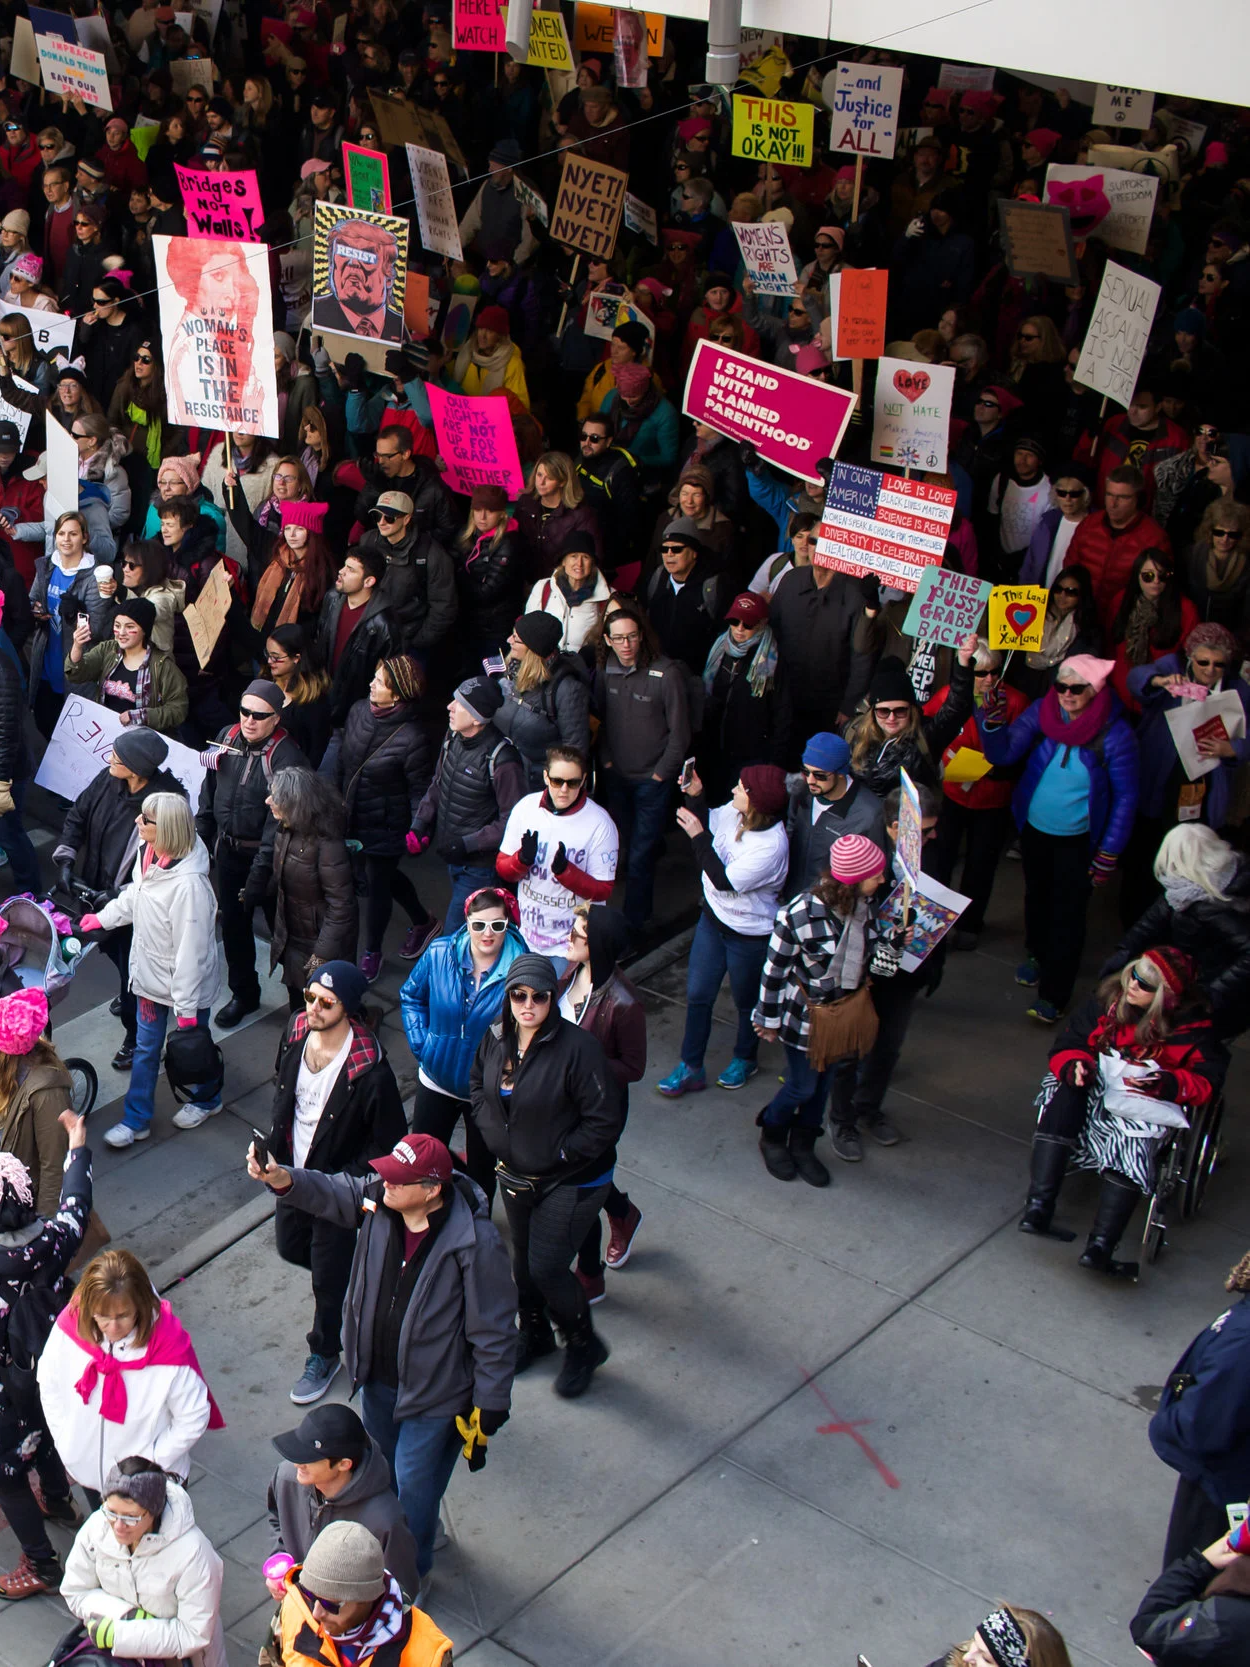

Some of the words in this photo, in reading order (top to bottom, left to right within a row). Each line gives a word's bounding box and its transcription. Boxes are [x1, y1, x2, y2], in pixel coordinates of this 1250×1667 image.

[456, 26, 498, 46] WATCH
[40, 49, 76, 67] DONALD
[77, 60, 107, 76] TRUMP
[51, 40, 96, 61] IMPEACH
[50, 71, 75, 86] SAVE
[77, 79, 97, 94] OUR
[741, 98, 798, 127] THIS
[834, 90, 893, 120] Justice
[1110, 97, 1133, 108] ME
[852, 110, 876, 132] for
[751, 124, 763, 138] IS
[768, 126, 801, 143] NOT
[742, 137, 806, 163] OKAY!!!
[178, 171, 248, 203] Bridges
[564, 164, 624, 205] NYET!
[1108, 178, 1149, 193] SUPPORT
[197, 198, 231, 216] NOT
[559, 189, 617, 231] NYET!
[553, 216, 612, 255] NYET!
[734, 223, 784, 248] WOMEN'S
[336, 244, 378, 264] RESIST
[743, 248, 790, 264] RIGHTS
[749, 271, 788, 283] HUMAN
[758, 262, 775, 272] ARE
[754, 282, 796, 294] RIGHTS
[1100, 273, 1150, 322] SEXUAL
[182, 319, 248, 343] WOMAN'S
[1090, 307, 1148, 352] ASSAULT
[196, 337, 236, 355] PLACE
[1087, 334, 1109, 359] IS
[1111, 344, 1141, 373] NOT
[198, 355, 215, 377] IS
[219, 357, 238, 378] IN
[715, 358, 724, 371] I
[724, 362, 779, 391] STAND
[199, 378, 240, 404] THE
[713, 372, 755, 399] WITH
[897, 375, 929, 391] LOVE
[1082, 361, 1096, 384] A
[1103, 367, 1134, 402] JOKE
[184, 401, 259, 424] RESISTANCE
[446, 395, 471, 410] OUR
[707, 385, 781, 424] PLANNED
[882, 402, 905, 416] NOT
[913, 406, 942, 419] HATE
[443, 405, 488, 425] RIGHTS
[704, 397, 811, 451] PARENTHOOD
[443, 417, 464, 435] ARE
[468, 424, 496, 438] NOT
[446, 431, 463, 446] UP
[469, 437, 497, 452] FOR
[452, 446, 498, 464] GRABS
[452, 463, 513, 485] NEITHER
[836, 467, 848, 481] IN
[850, 471, 872, 488] OUR
[831, 486, 874, 509] AMERICA
[886, 478, 912, 494] LOVE
[915, 485, 925, 497] IS
[928, 488, 953, 504] LOVE
[880, 493, 903, 508] BLACK
[903, 499, 921, 511] LIVES
[921, 503, 950, 521] MATTER
[823, 512, 848, 526] WOMEN
[848, 516, 868, 530] SPEAK
[873, 524, 896, 539] CHOOSE
[895, 530, 906, 542] FOR
[908, 534, 943, 551] THEMSELVES
[877, 508, 912, 527] SCIENCE
[914, 518, 923, 530] IS
[923, 521, 947, 537] REAL
[824, 526, 870, 548] DIVERSITY
[871, 539, 881, 552] IS
[882, 542, 937, 566] CELEBRATED
[824, 541, 875, 566] HEALTHCARE
[875, 556, 902, 573] SAVES
[902, 564, 922, 579] LIVE
[937, 569, 982, 595] THIS
[926, 584, 986, 617] PUSSY
[1002, 589, 1023, 603] This
[1026, 589, 1048, 605] Land
[920, 603, 975, 630] GRABS
[917, 620, 968, 648] BACK
[1000, 632, 1020, 645] Your
[1020, 633, 1040, 646] Land
